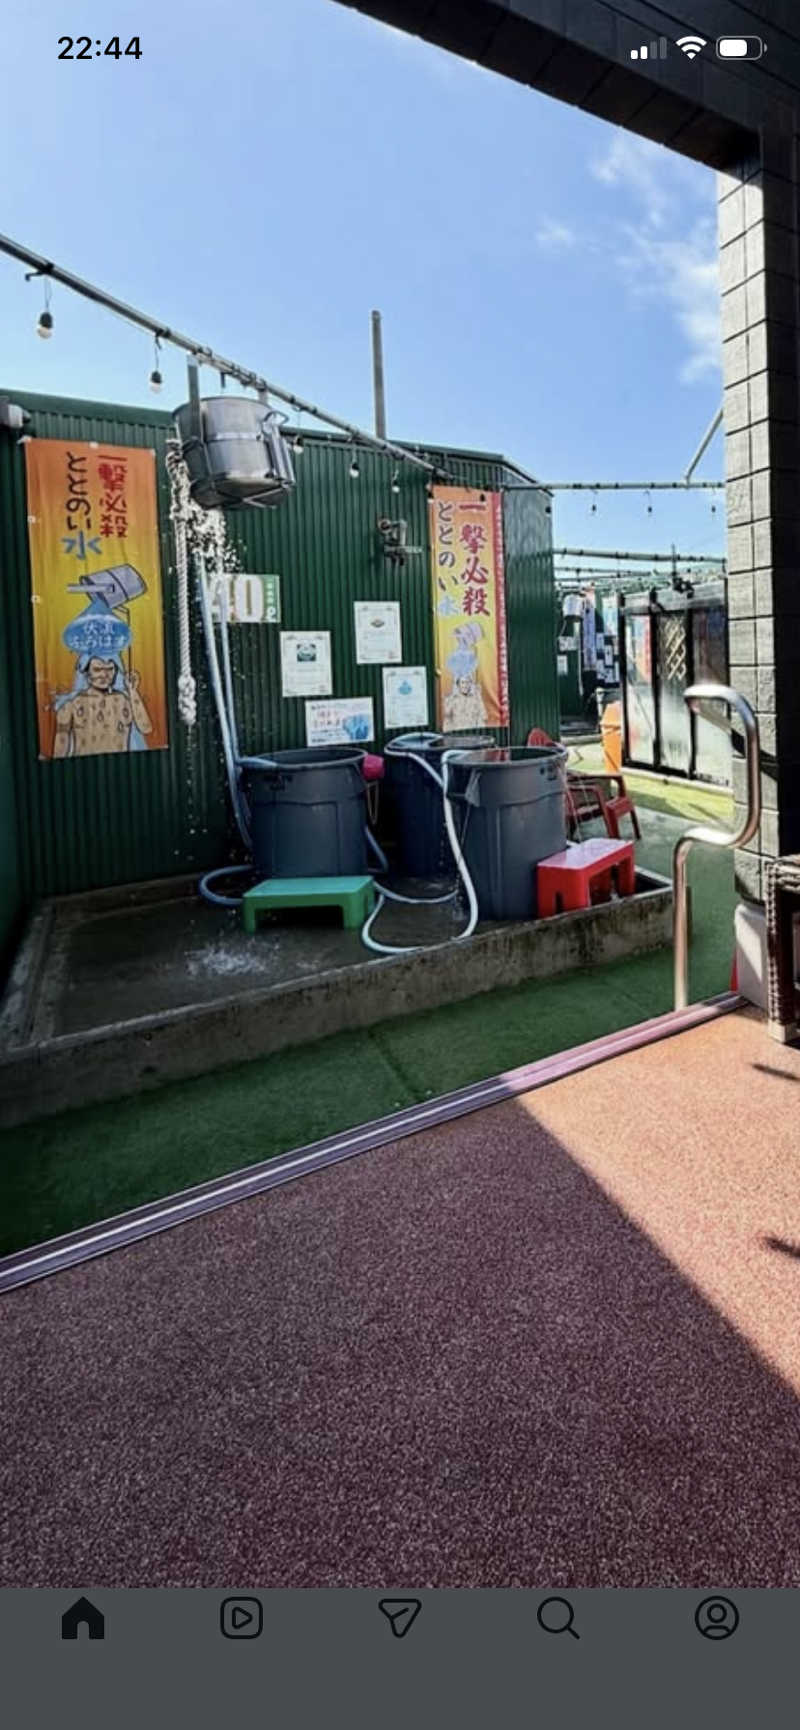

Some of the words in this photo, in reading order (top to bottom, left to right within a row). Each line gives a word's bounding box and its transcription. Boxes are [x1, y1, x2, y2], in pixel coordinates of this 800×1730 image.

[61, 451, 102, 561] ととのい水
[98, 455, 128, 538] 一撃必殺
[459, 503, 490, 616] 一撃必殺
